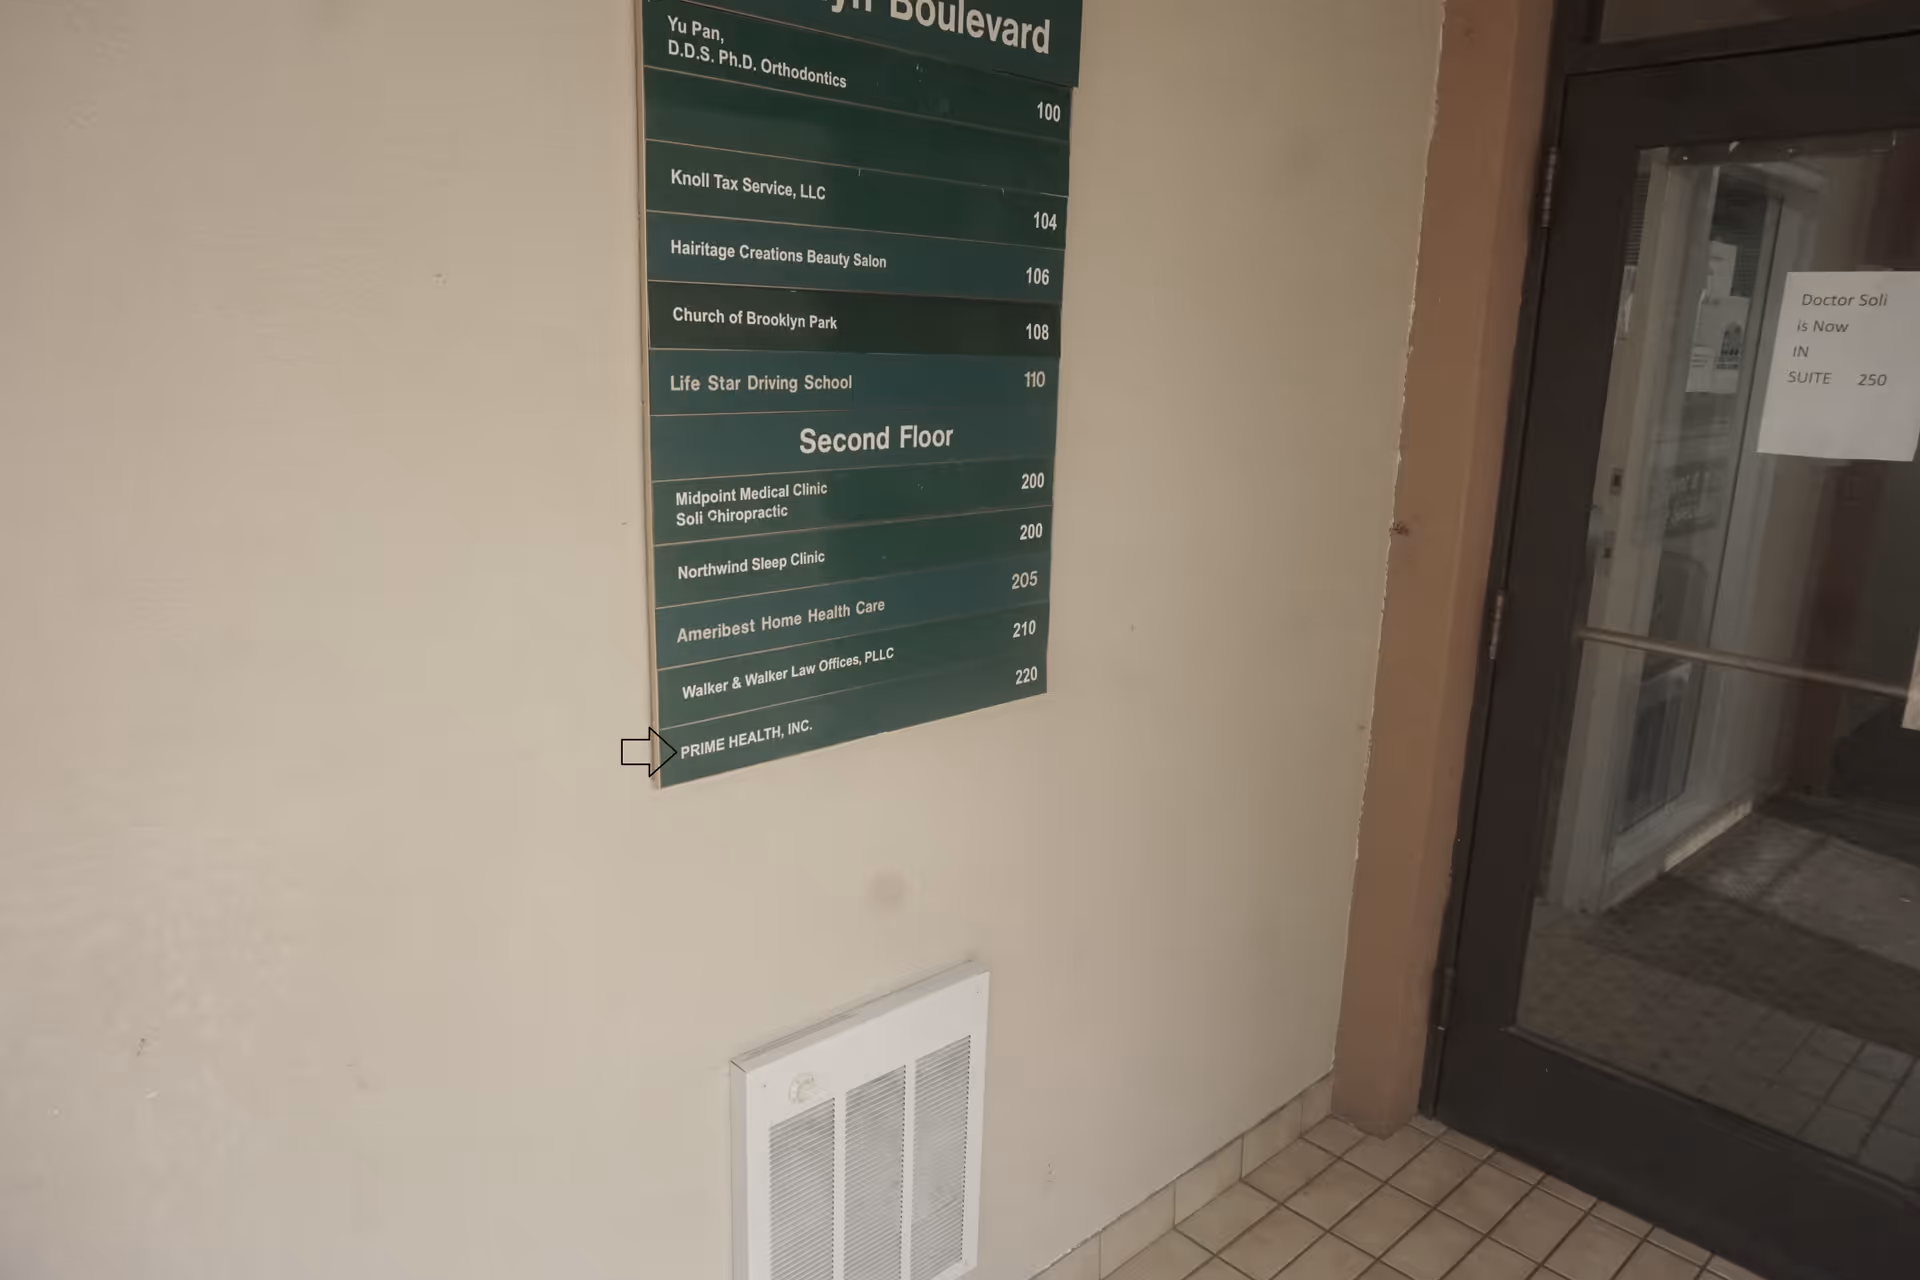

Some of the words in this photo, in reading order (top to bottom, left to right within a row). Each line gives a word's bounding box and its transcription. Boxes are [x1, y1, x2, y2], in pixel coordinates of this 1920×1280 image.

[667, 15, 687, 34] Yu
[691, 20, 724, 45] Pan,
[890, 0, 1051, 55] Boulevard
[668, 39, 714, 63] D.D.S.
[718, 49, 757, 72] Ph.D.
[760, 58, 847, 89] Orthodontics
[1037, 101, 1061, 123] 100
[670, 168, 710, 189] Knoll
[712, 173, 739, 192] Tax
[742, 176, 797, 200] Service,
[800, 183, 826, 201] LLC
[1033, 211, 1058, 231] 104
[670, 239, 736, 263] Hairitage
[739, 243, 804, 263] Creations
[806, 249, 850, 270] Beauty
[853, 252, 888, 269] Salon
[1025, 266, 1050, 286] 106
[1801, 293, 1855, 307] Doctor
[1858, 293, 1889, 307] Soli
[672, 306, 725, 325] Church
[728, 310, 744, 326] of
[746, 310, 806, 330] Brooklyn
[809, 316, 838, 330] Park
[1796, 319, 1809, 333] is
[1813, 319, 1850, 333] Now
[1025, 322, 1050, 341] 108
[1792, 345, 1809, 359] IN
[670, 374, 701, 392] Life
[707, 374, 742, 392] Star
[747, 373, 799, 394] Driving
[803, 374, 853, 391] School
[1023, 370, 1047, 389] 110
[1786, 370, 1832, 386] SUITE
[1857, 373, 1888, 387] 250
[799, 425, 891, 455] Second
[899, 424, 955, 449] Floor
[1020, 471, 1046, 491] 200
[675, 489, 737, 508] Midpoint
[739, 484, 791, 502] Medical
[792, 481, 829, 497] Clinic
[675, 510, 704, 527] Soli
[707, 503, 789, 524] Chiropractic
[1018, 522, 1044, 542] 200
[676, 559, 749, 581] Northwind
[751, 554, 788, 574] Sleep
[790, 550, 826, 567] Clinic
[1011, 570, 1039, 591] 205
[676, 618, 756, 645] Ameribest
[761, 614, 803, 632] Home
[807, 603, 852, 624] Health
[855, 599, 886, 616] Care
[1012, 619, 1038, 640] 210
[681, 679, 729, 701] Walker
[731, 675, 743, 690] &
[744, 668, 789, 688] Walker
[790, 664, 817, 679] Law
[818, 655, 863, 674] Offices,
[863, 646, 895, 664] PLLC
[1015, 665, 1039, 687] 220
[680, 736, 726, 760] PRIME
[728, 725, 786, 750] HEALTH,
[787, 718, 814, 736] INC.
